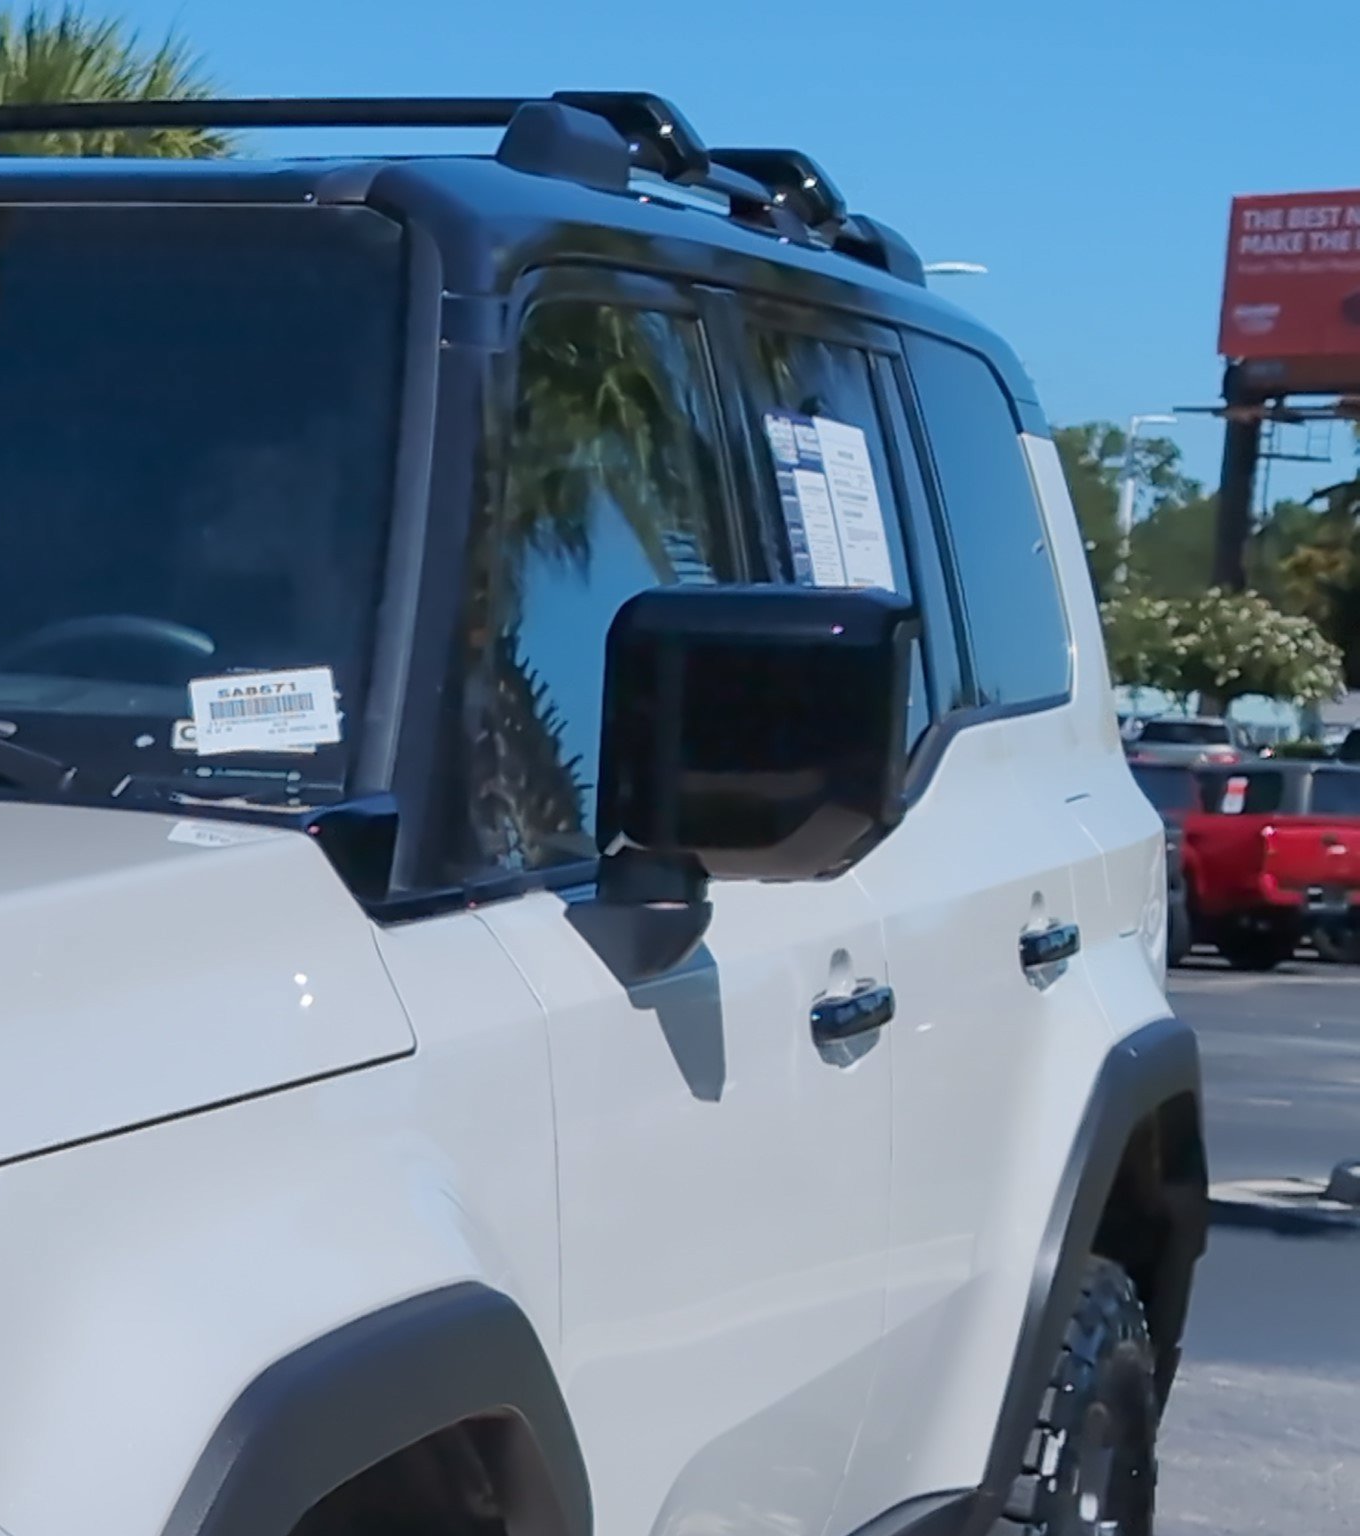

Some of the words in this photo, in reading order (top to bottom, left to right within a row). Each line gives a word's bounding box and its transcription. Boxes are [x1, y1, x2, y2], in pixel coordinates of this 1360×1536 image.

[1243, 208, 1283, 231] THE
[1288, 206, 1341, 230] BEST
[1240, 232, 1304, 254] MAKE
[1310, 230, 1351, 252] THE
